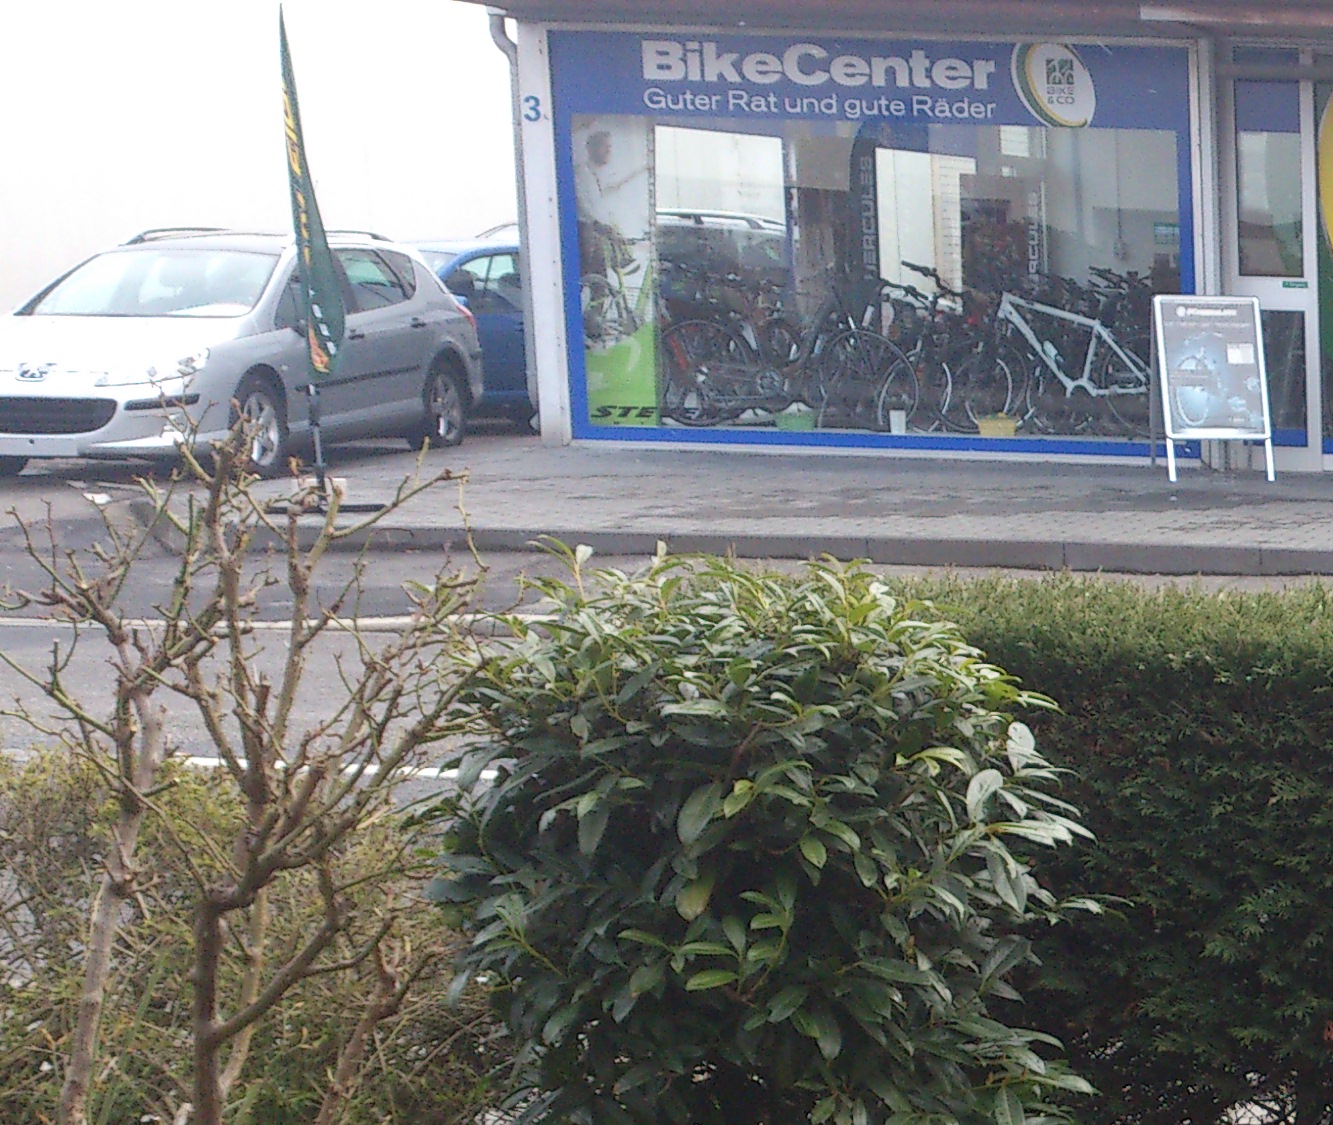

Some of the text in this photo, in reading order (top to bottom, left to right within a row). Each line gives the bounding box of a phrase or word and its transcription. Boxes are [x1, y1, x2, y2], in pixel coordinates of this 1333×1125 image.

[642, 39, 996, 90] BikeCenter
[523, 95, 541, 122] 3
[643, 87, 996, 119] Guter Rat und gute Räder
[860, 155, 876, 280] HERCULES
